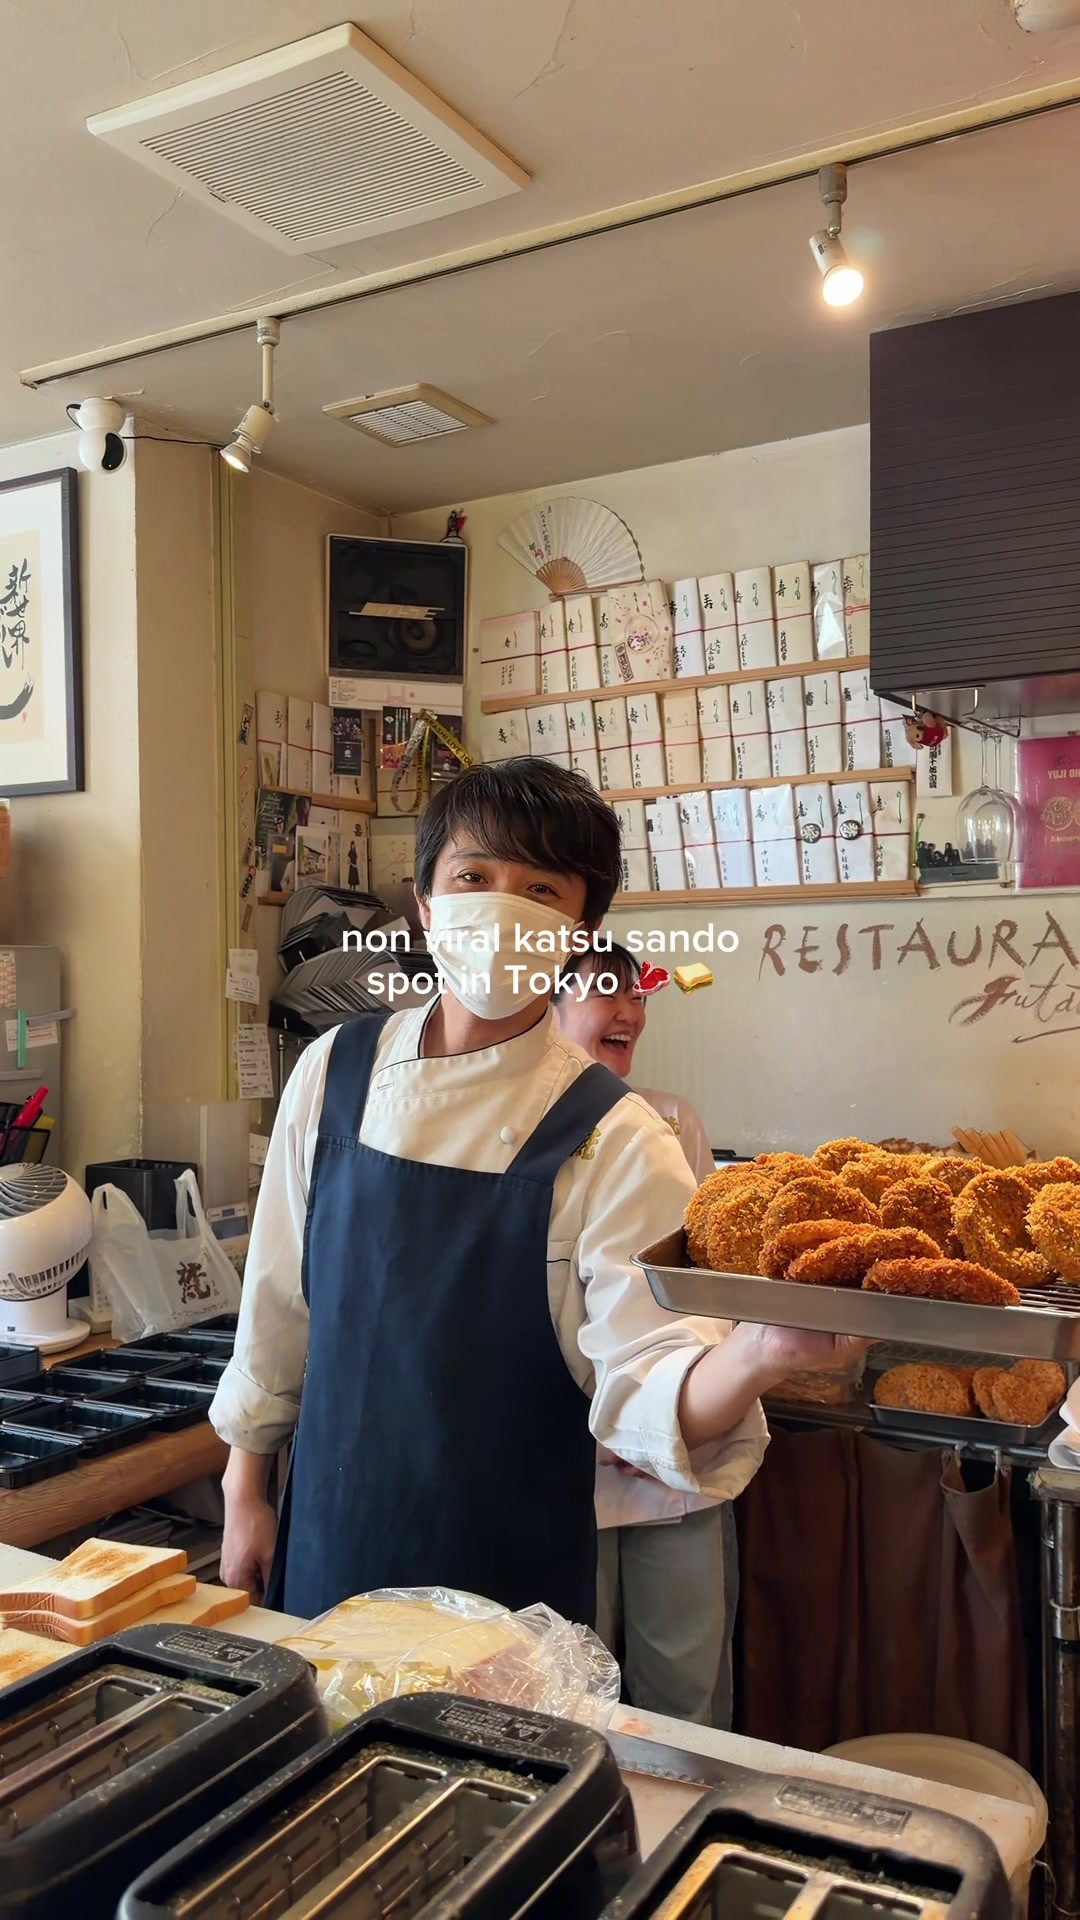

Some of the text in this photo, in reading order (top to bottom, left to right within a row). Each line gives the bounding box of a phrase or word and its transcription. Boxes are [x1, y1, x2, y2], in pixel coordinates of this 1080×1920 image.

[775, 578, 787, 598] 寿
[447, 737, 461, 754] LIVE
[1047, 769, 1067, 780] YUJI
[758, 910, 1080, 982] RESTAURA
